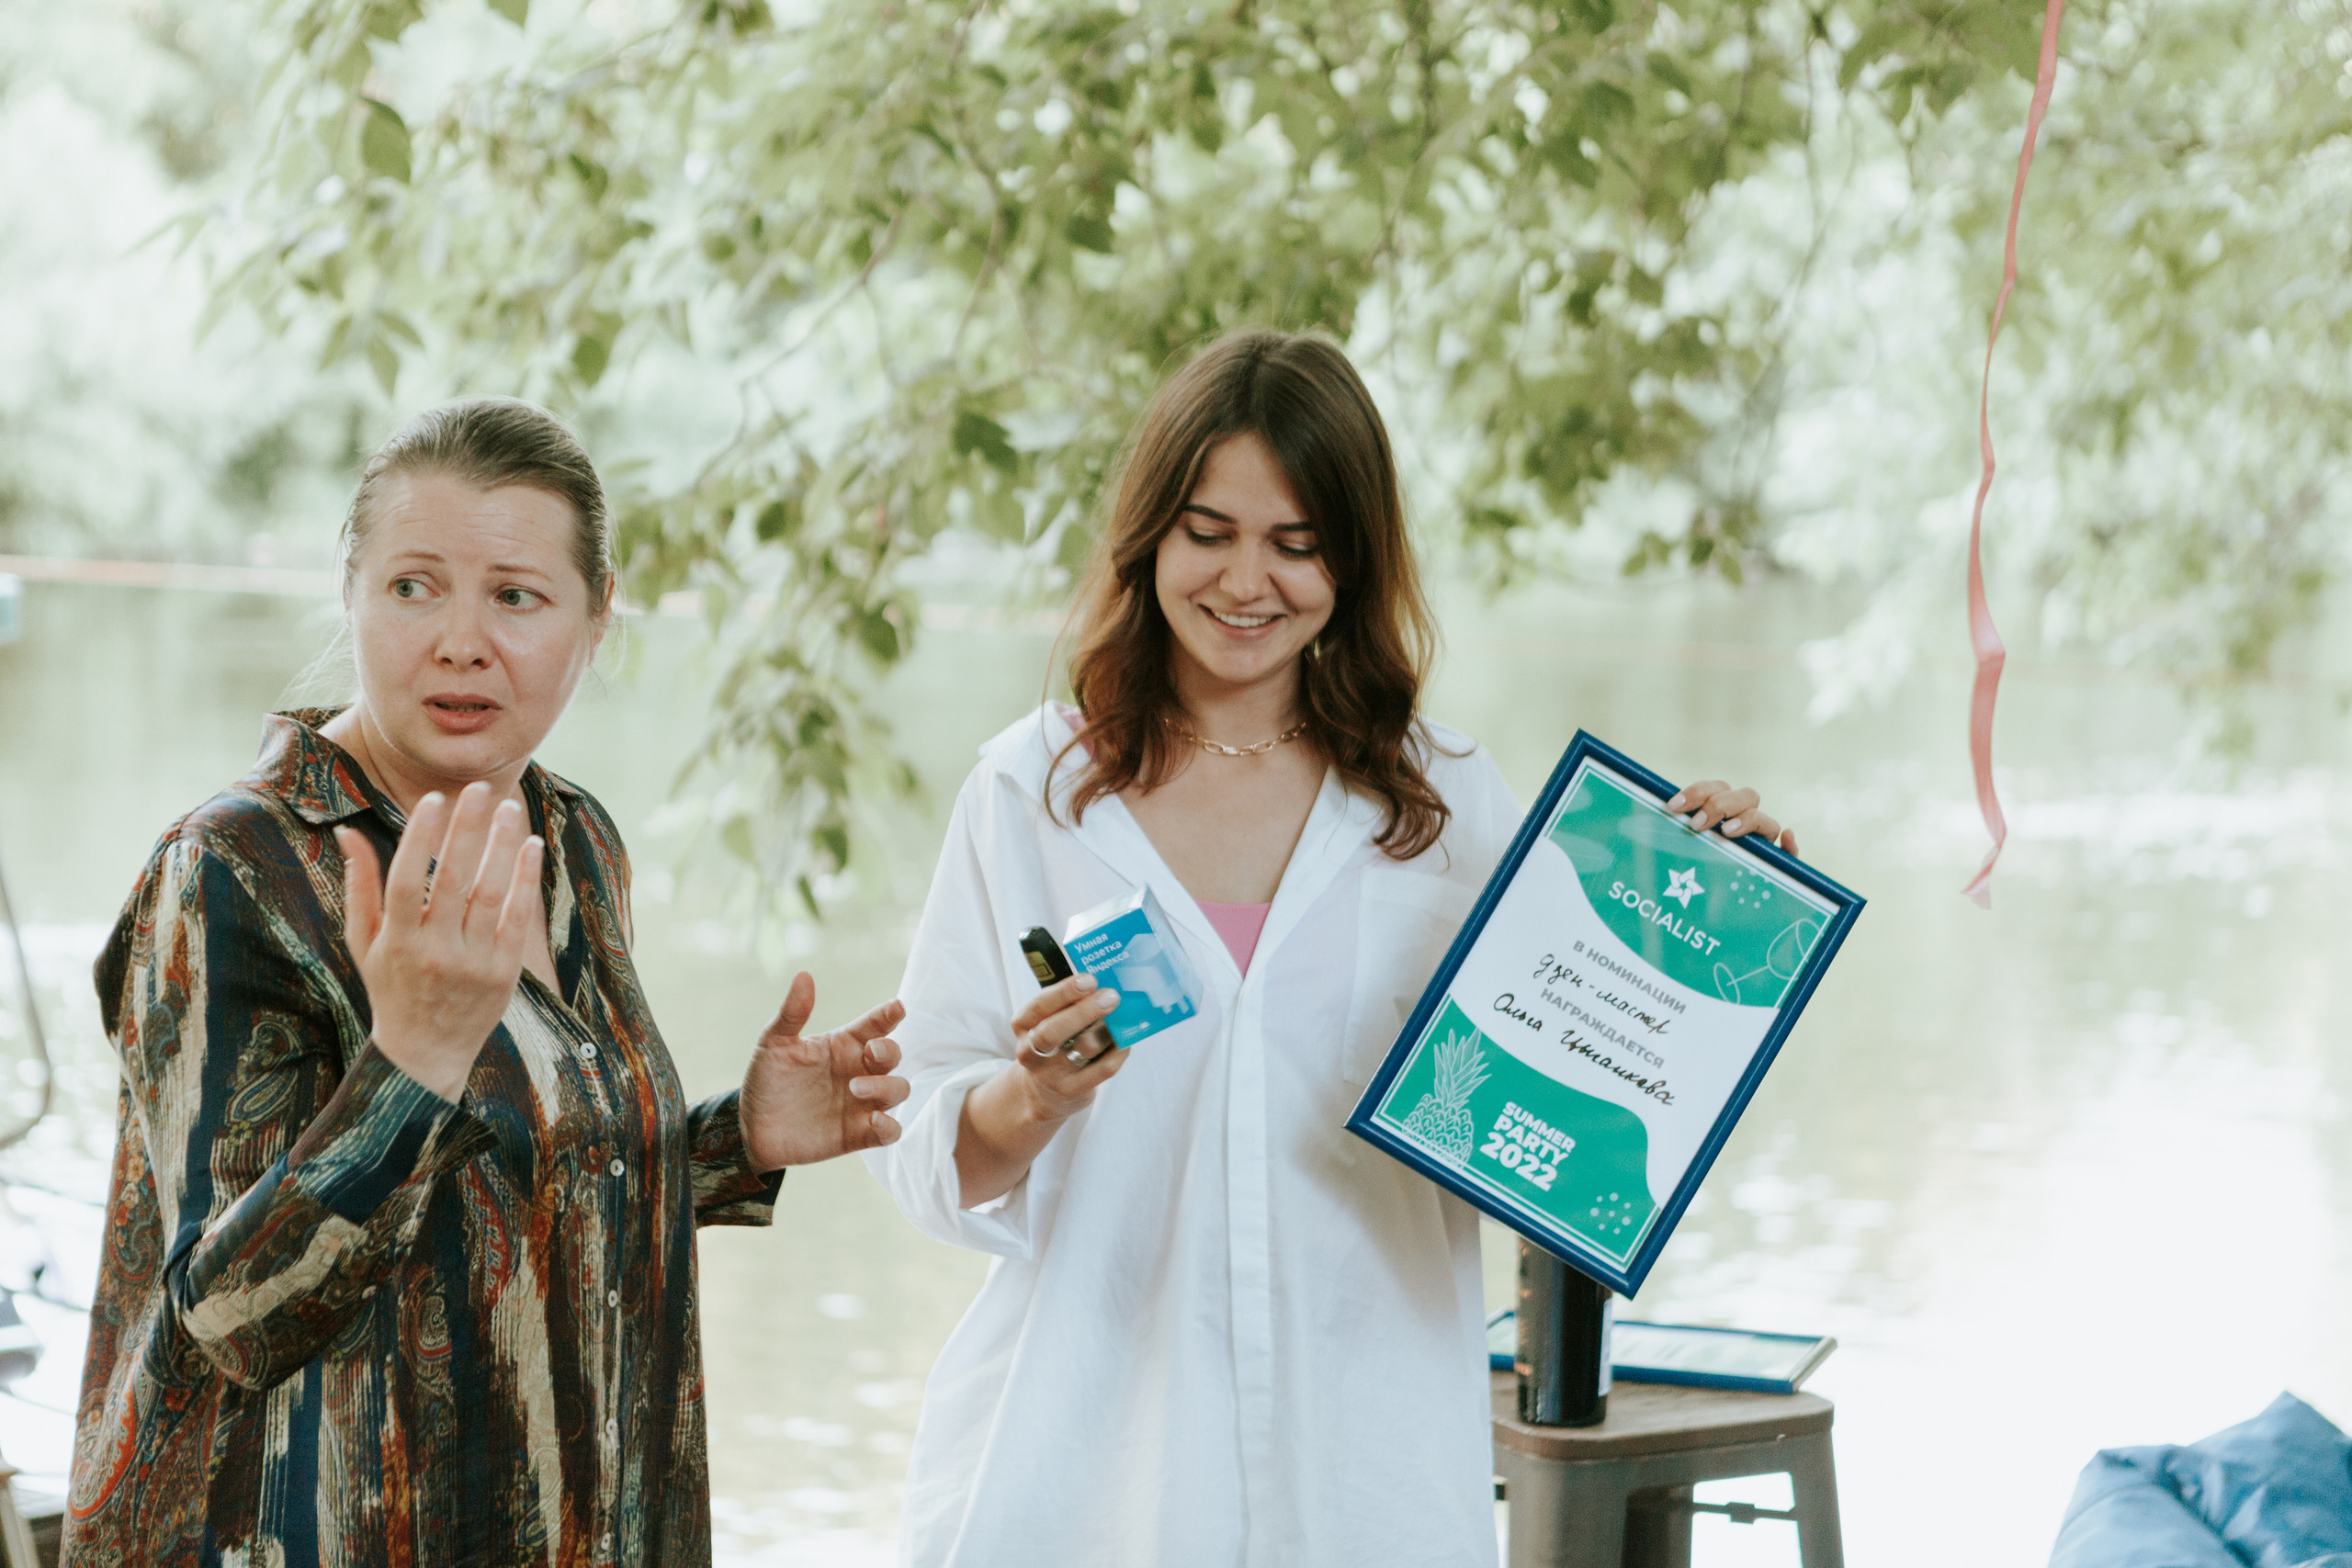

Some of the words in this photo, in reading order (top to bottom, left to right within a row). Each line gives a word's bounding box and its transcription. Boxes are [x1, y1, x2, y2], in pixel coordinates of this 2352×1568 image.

[1073, 933, 1109, 954] Умная
[1608, 881, 1721, 956] SOCIALIST
[1080, 941, 1123, 967] розетка
[1085, 951, 1130, 975] Яндекса
[1572, 940, 1586, 953] В
[1586, 946, 1687, 1015] НОМИНАЦИИ
[1492, 992, 1544, 1032] Ольга
[1540, 987, 1666, 1070] НАГРАЖДАЕТСЯ
[1493, 1113, 1570, 1167] PARTY
[1502, 1100, 1577, 1154] SUMMER
[1479, 1131, 1558, 1192] 2022
